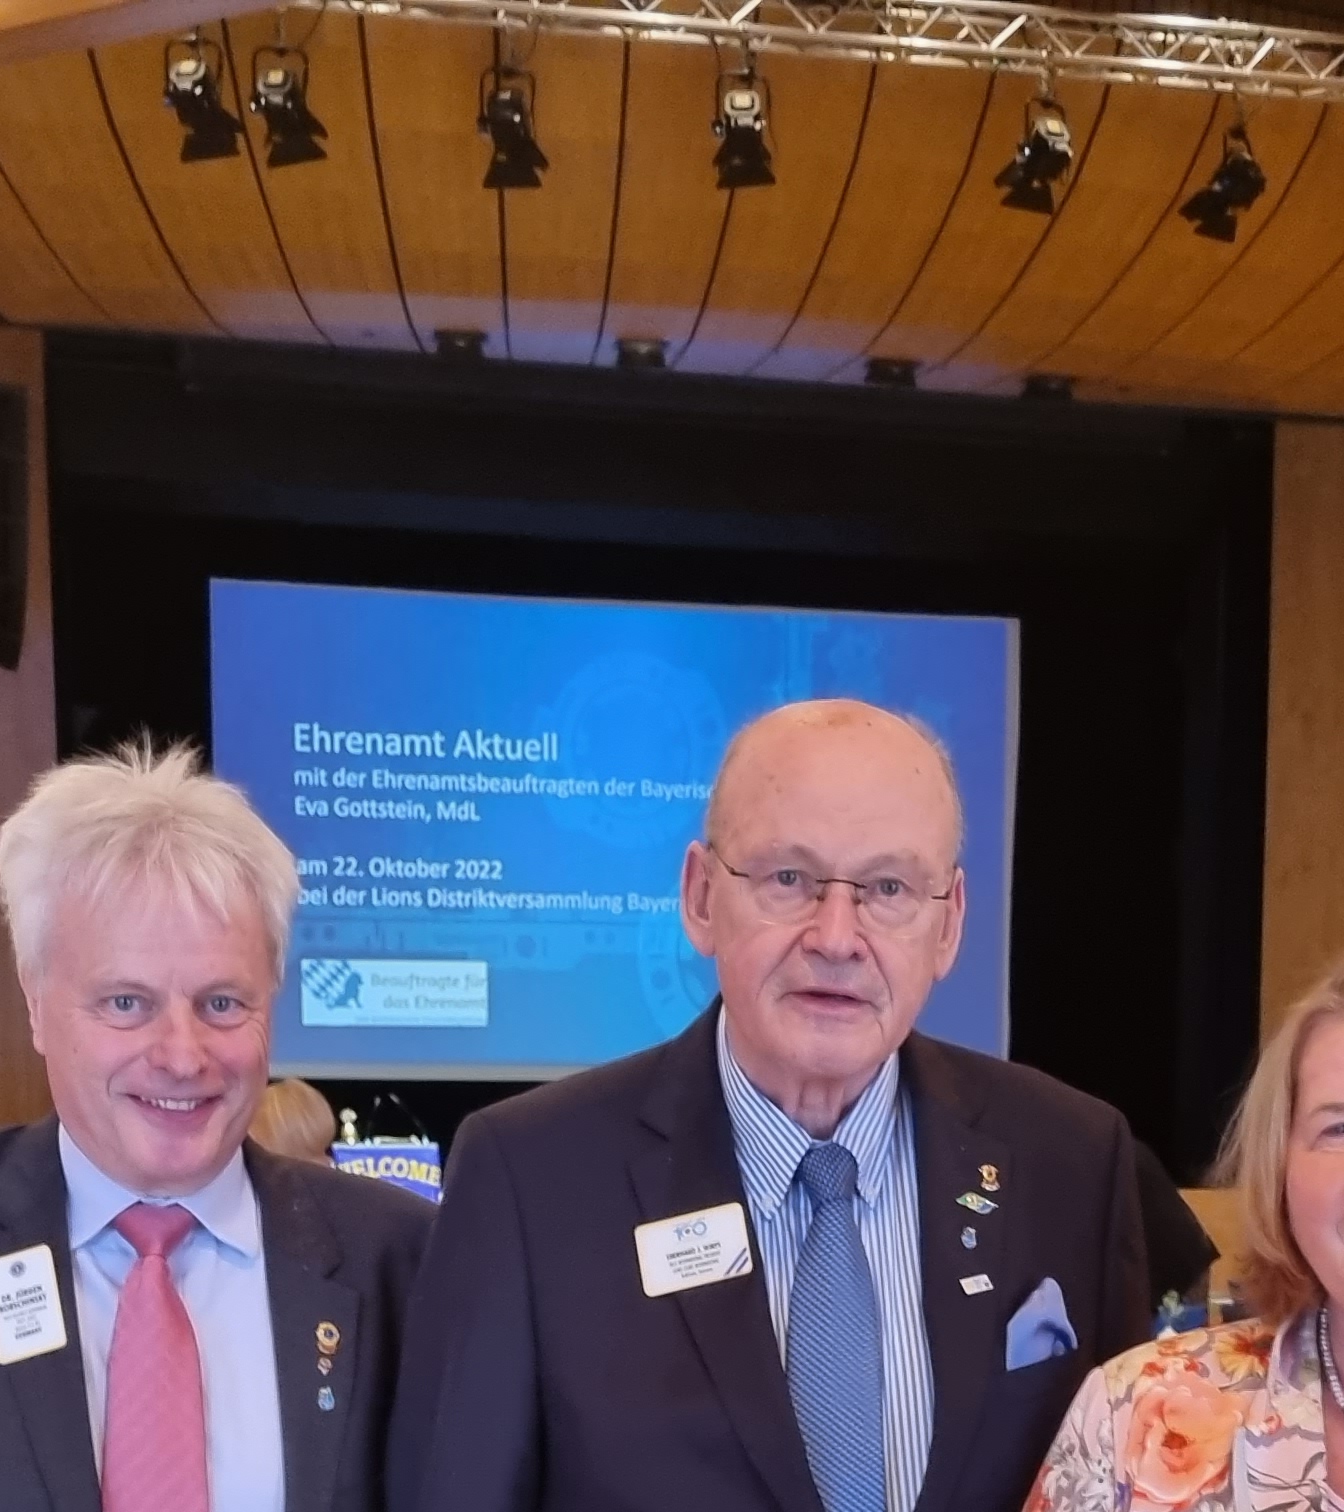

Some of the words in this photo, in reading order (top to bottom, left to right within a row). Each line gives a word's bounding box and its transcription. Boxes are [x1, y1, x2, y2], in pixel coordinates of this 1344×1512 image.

[293, 722, 446, 758] Ehrenamt
[454, 730, 559, 761] Aktuell
[294, 767, 328, 788] mit
[332, 768, 367, 789] der
[372, 769, 600, 798] Ehrenamtsbeauftragten
[604, 777, 635, 797] der
[294, 796, 330, 817] Eva
[333, 796, 432, 824] Gottstein,
[436, 800, 481, 822] MdL
[297, 859, 328, 877] am
[332, 855, 364, 878] 22.
[368, 856, 450, 879] Oktober
[454, 859, 503, 881] 2022
[332, 886, 367, 907] der
[371, 887, 422, 909] Lions
[426, 888, 623, 913] Distriktversammlung
